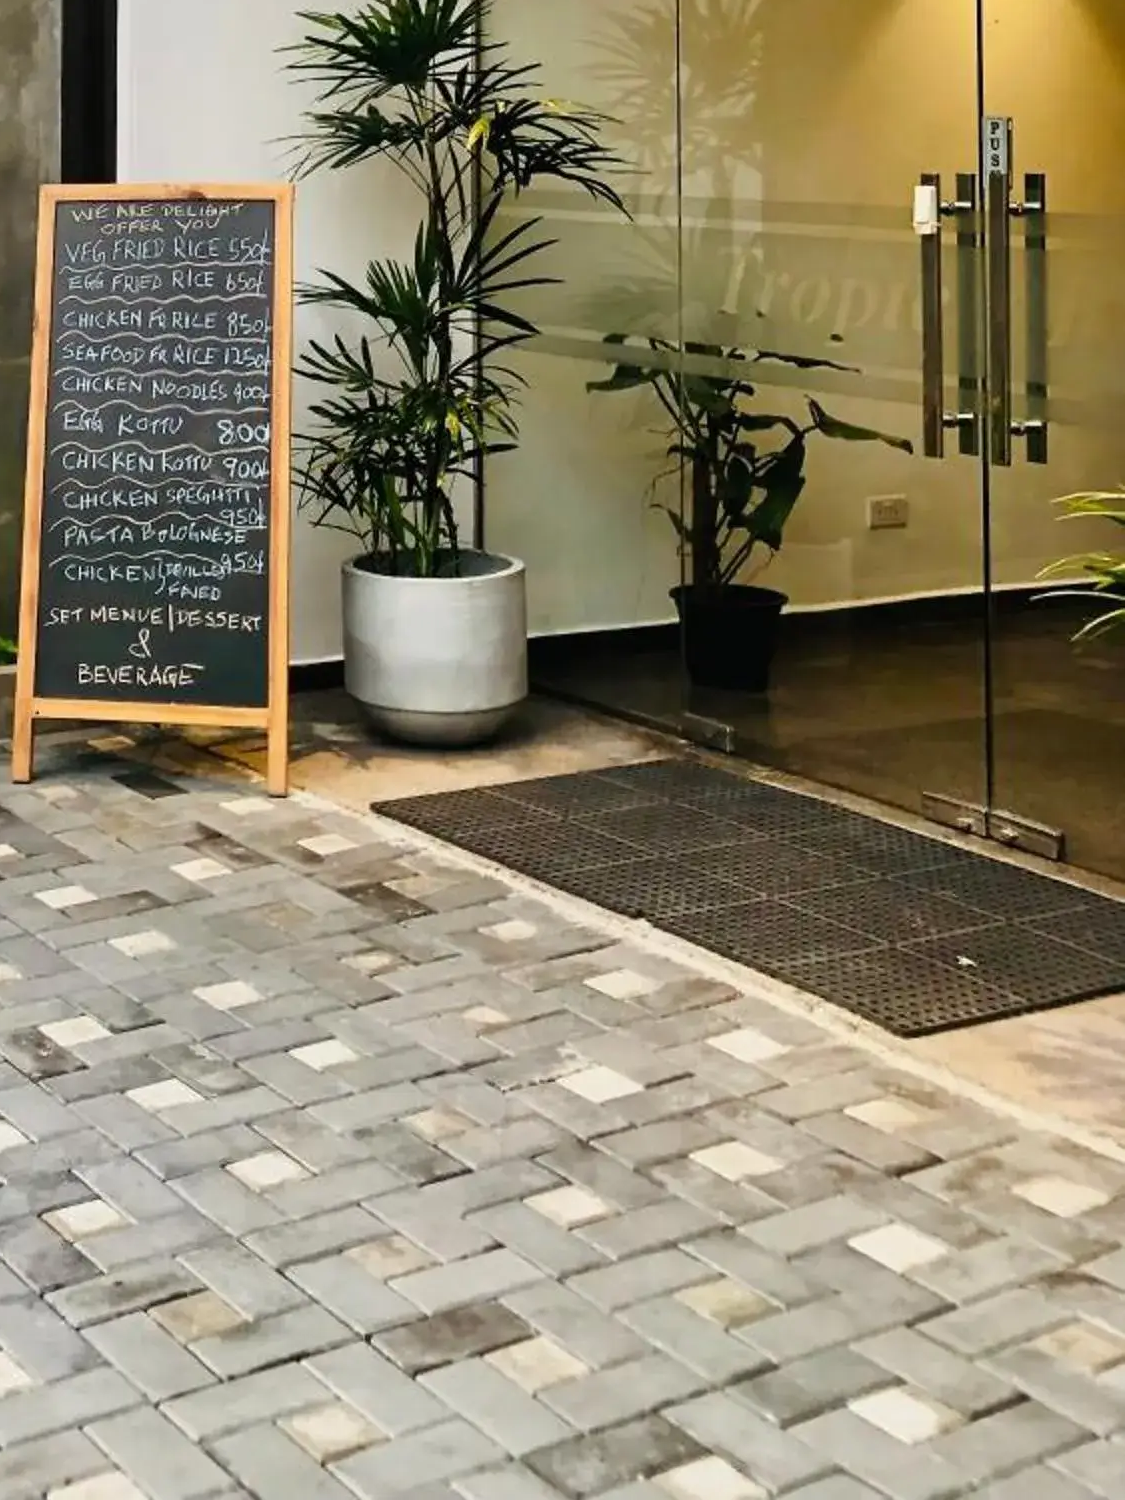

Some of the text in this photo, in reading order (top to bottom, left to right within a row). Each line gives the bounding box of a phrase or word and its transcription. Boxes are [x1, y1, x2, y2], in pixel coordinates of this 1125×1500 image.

[71, 204, 108, 222] WE
[100, 216, 221, 235] OFFER YOU
[113, 237, 165, 260] FRIED
[174, 235, 221, 258] RICE
[68, 274, 105, 290] EGG
[112, 273, 163, 293] FRIED
[172, 269, 215, 289] RICE
[62, 308, 142, 329] CHICKEN
[172, 310, 218, 329] RICE
[61, 345, 146, 366] SEAFOOD
[173, 343, 219, 365] RICE
[62, 375, 143, 394] CHICKEN
[152, 379, 228, 402] NOODLES
[61, 451, 154, 474] CHICKEN
[62, 488, 159, 510] CHICKEN
[63, 522, 135, 547] PASTA
[64, 564, 156, 583] CHICKEN
[43, 605, 262, 632] SET MENUE DESSERT
[78, 662, 205, 687] BEVERAGE
